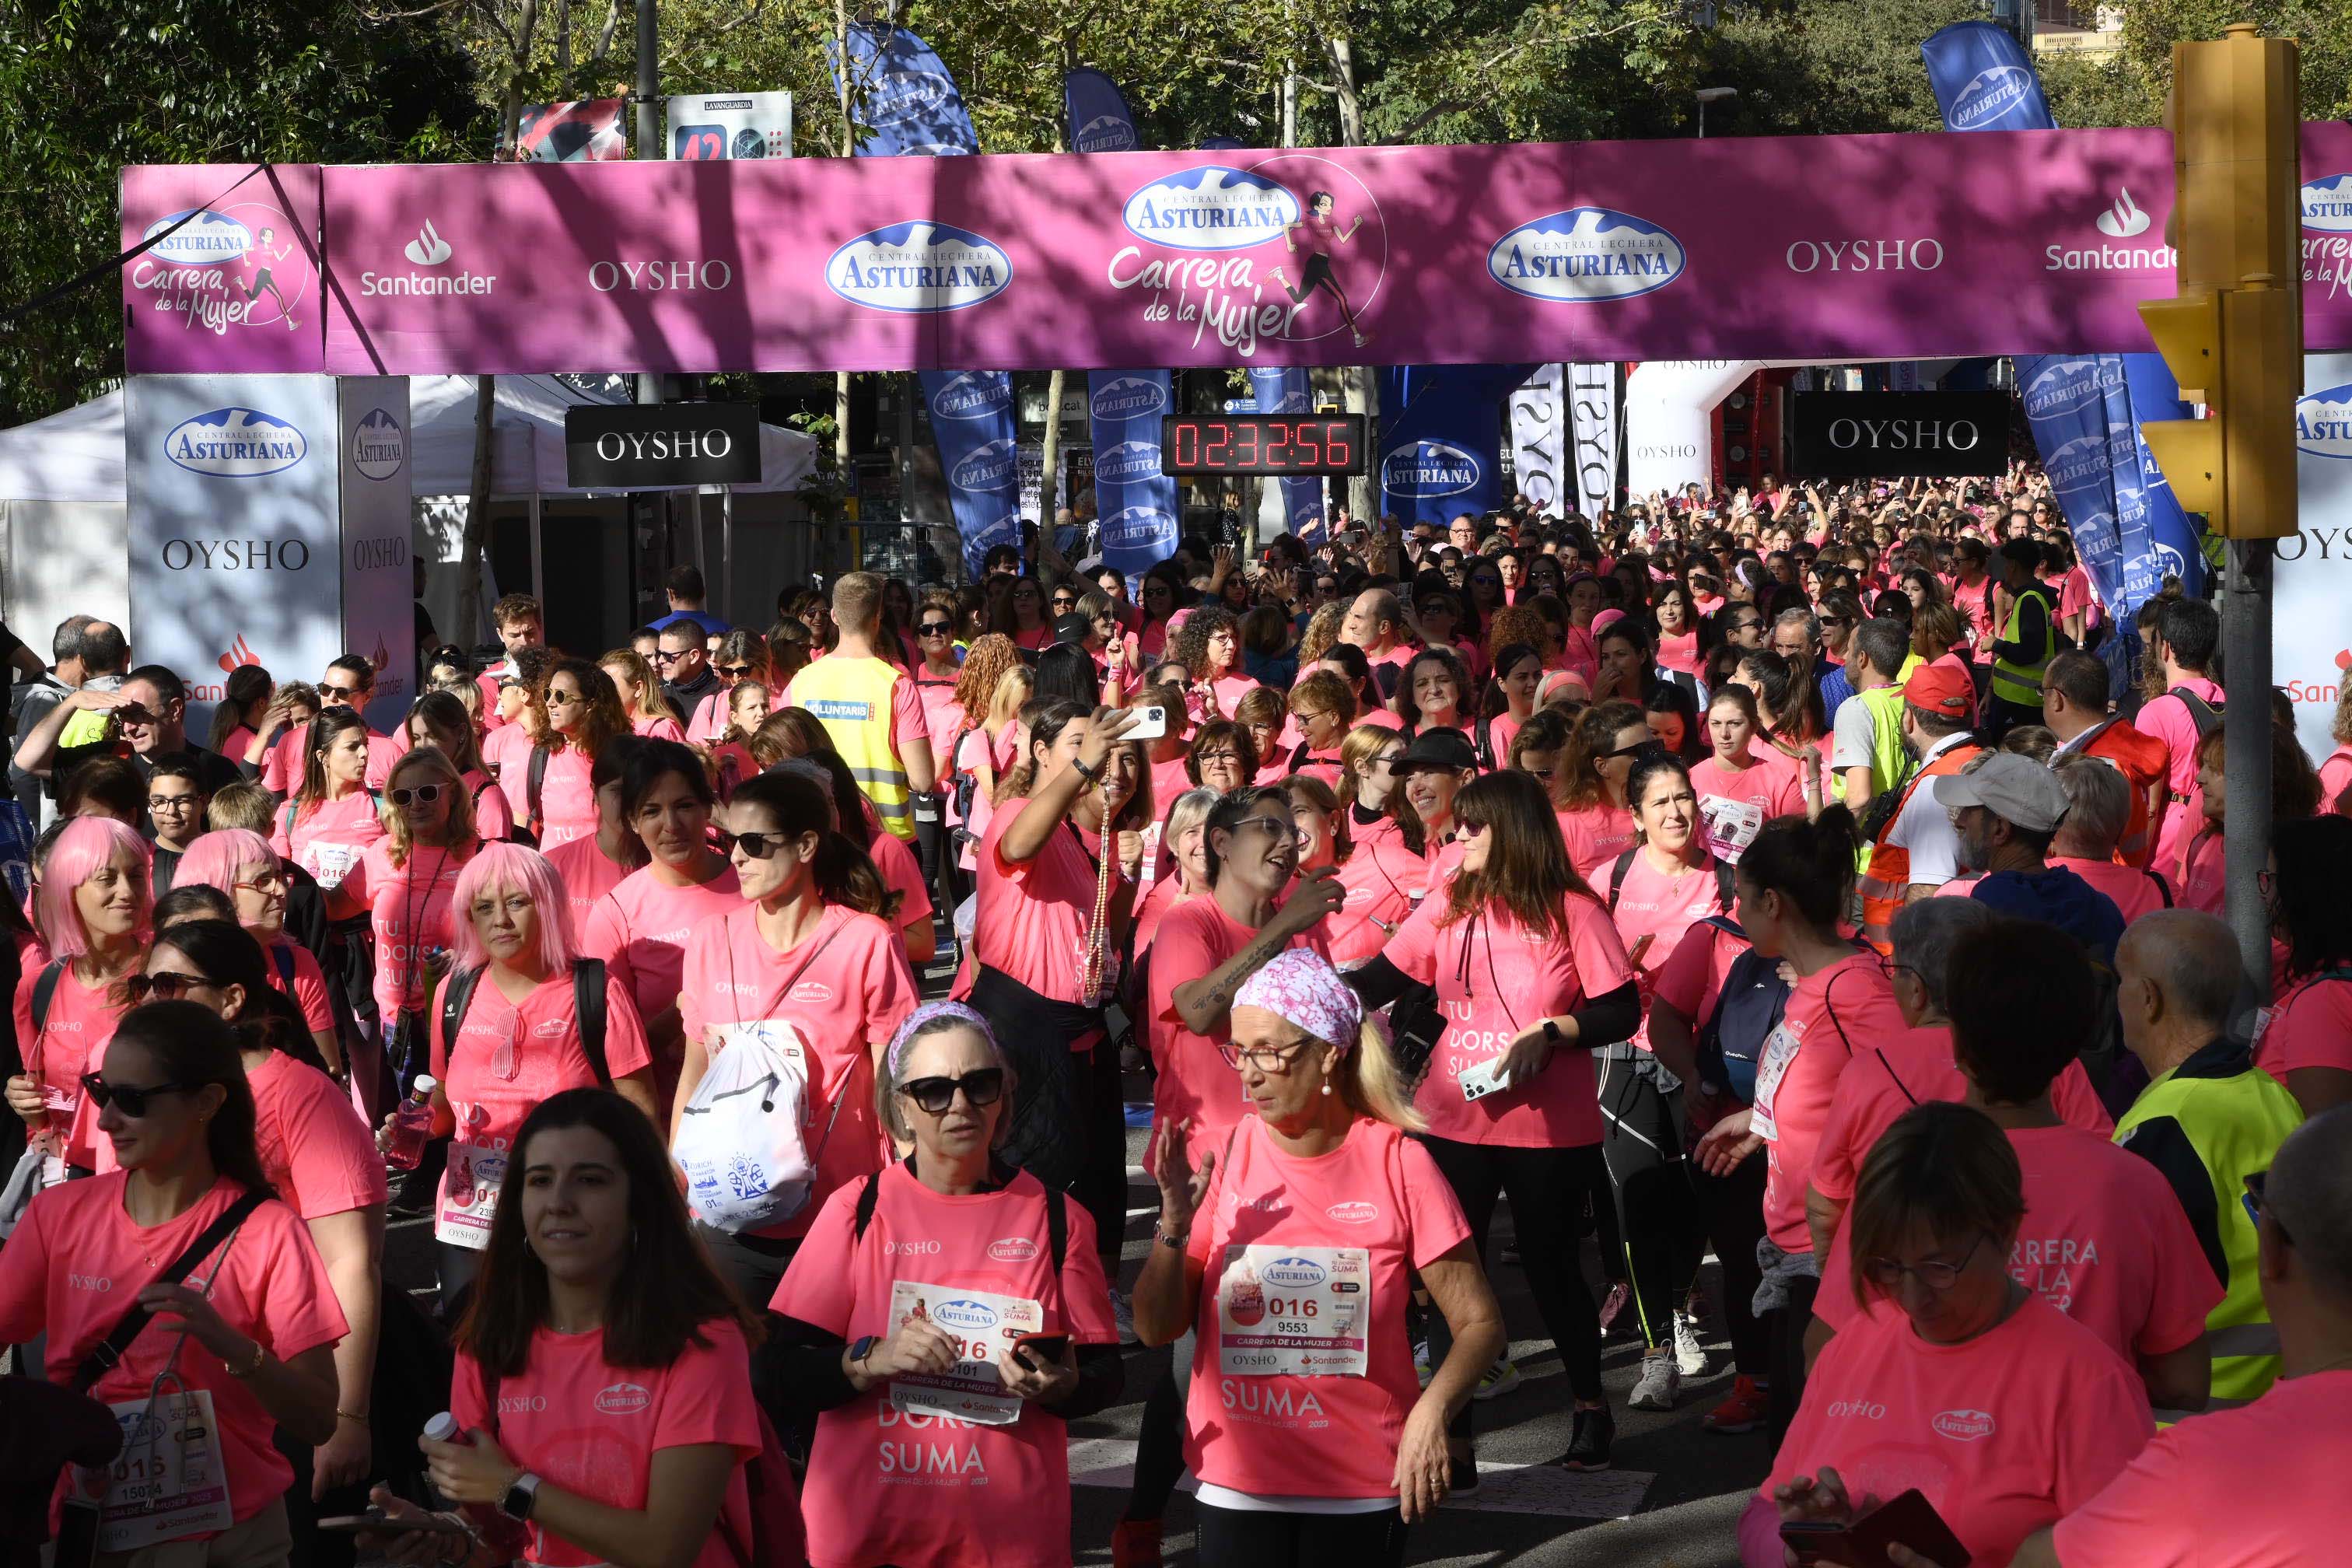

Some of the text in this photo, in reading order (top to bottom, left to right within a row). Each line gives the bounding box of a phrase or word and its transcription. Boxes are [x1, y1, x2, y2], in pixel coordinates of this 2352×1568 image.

[1164, 194, 1282, 203] CENTRAL LECHERA
[1137, 198, 1286, 229] ASTURIANA
[152, 229, 243, 250] ASTURIANA
[1533, 239, 1664, 250] CENTRAL LECHERA
[868, 251, 992, 261] CENTRAL LECHERA
[1502, 243, 1671, 279] ASTURIANA
[1786, 238, 1944, 273] OYSHO
[2045, 244, 2179, 271] Santande
[132, 260, 224, 290] Carrera
[588, 260, 732, 292] OYSHO
[840, 255, 998, 289] ASTURIANA
[1108, 245, 1251, 290] Carrera
[2317, 259, 2332, 282] la
[360, 270, 497, 296] Santander
[155, 289, 259, 335] de la Mujer
[1144, 284, 1308, 357] de la Mujer
[196, 431, 292, 439] CENTRAL LECHERA
[1828, 418, 1979, 451] OYSHO
[176, 433, 296, 460] ASTURIANA
[355, 434, 402, 463] ASTURIANA
[596, 428, 732, 462] OYSHO
[1174, 422, 1349, 467] 02:32:56
[1636, 444, 1696, 459] OYSHO
[1020, 479, 1043, 491] quiere
[1384, 467, 1472, 486] ASTURIANA
[161, 538, 310, 572] OYSHO
[353, 535, 405, 572] OYSHO
[373, 675, 404, 698] tander
[554, 827, 574, 841] TU
[322, 868, 346, 879] 016
[1622, 901, 1659, 912] OYSHO
[376, 919, 398, 936] TU
[646, 927, 691, 946] OYSHO
[381, 944, 430, 962] DORS
[1724, 943, 1745, 953] OYS
[715, 982, 759, 998] OYSHO
[1446, 1000, 1473, 1021] TU
[1450, 1029, 1510, 1052] DORS
[452, 1101, 481, 1124] TU
[478, 1166, 502, 1177] ASTUR
[477, 1188, 498, 1203] 01
[453, 1214, 480, 1227] CARRERA
[1331, 1208, 1377, 1220] ASTURIANA
[448, 1227, 479, 1241] OYSHO
[884, 1240, 941, 1256] OYSHO
[991, 1246, 1035, 1258] ASTURIANA
[2007, 1240, 2099, 1265] RRERA
[1266, 1268, 1321, 1281] ASTURIANA
[1332, 1265, 1359, 1273] SUMA
[2037, 1268, 2072, 1292] LA
[1003, 1311, 1031, 1321] SUMA
[1269, 1297, 1318, 1317] 016
[938, 1310, 993, 1325] ASTURIANA
[1278, 1321, 1308, 1334] 9553
[960, 1339, 987, 1360] 16
[1237, 1337, 1276, 1346] CARRERA
[1303, 1339, 1332, 1347] MUJER
[1232, 1355, 1357, 1366] OYSHO Santander
[898, 1374, 996, 1394] CARRERA DE LA MUJER
[497, 1395, 547, 1413] OYSHO
[597, 1394, 648, 1409] ASTURIANA
[894, 1389, 938, 1405] OYSHO
[1221, 1379, 1324, 1416] SUMA
[1827, 1399, 1887, 1420] OYHO
[878, 1441, 985, 1475] SUMA
